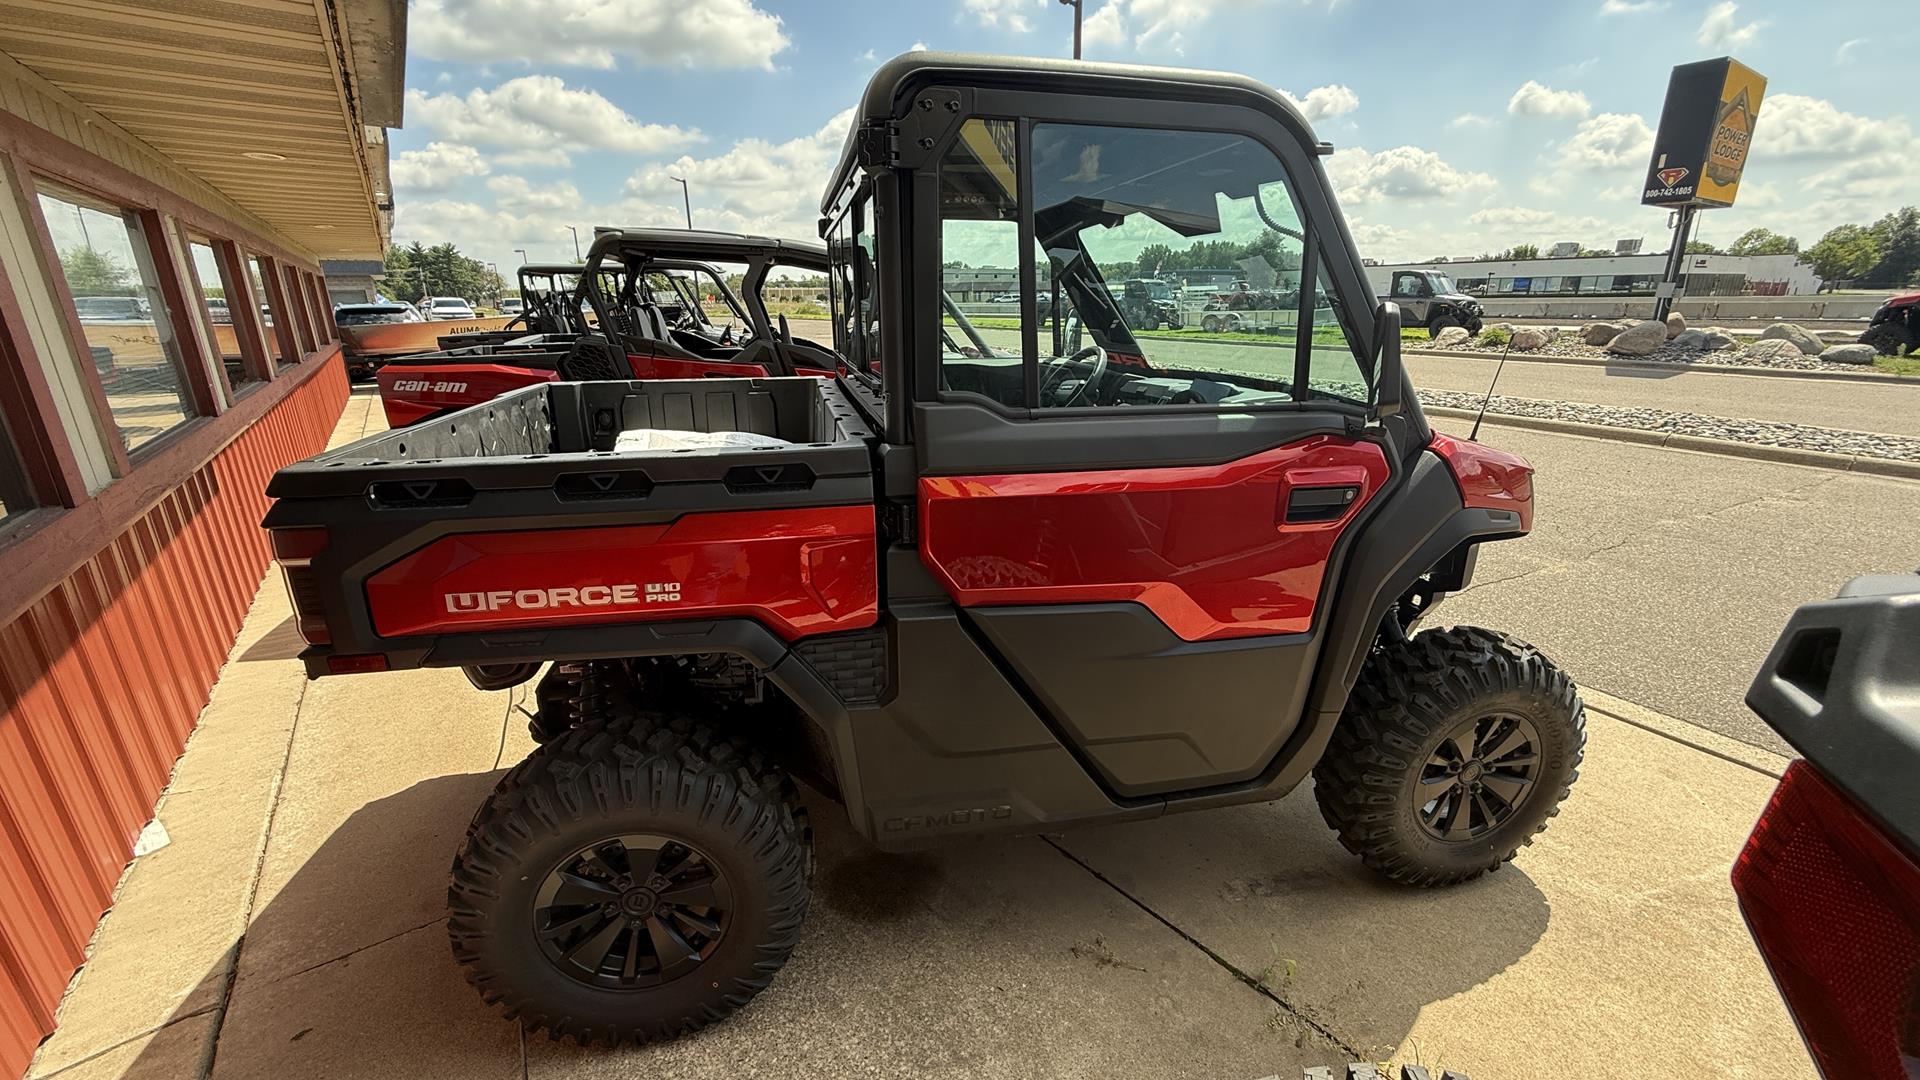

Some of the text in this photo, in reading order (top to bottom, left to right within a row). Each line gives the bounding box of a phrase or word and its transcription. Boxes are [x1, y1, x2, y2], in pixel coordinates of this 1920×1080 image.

[1716, 125, 1748, 146] POWER
[1714, 141, 1743, 161] LODGE
[1645, 186, 1692, 198] 800-742-1805
[393, 380, 467, 393] can-am
[644, 583, 681, 592] U10
[445, 584, 639, 613] UFORCE
[646, 593, 681, 602] PRO
[883, 805, 1012, 832] CFMOTO
